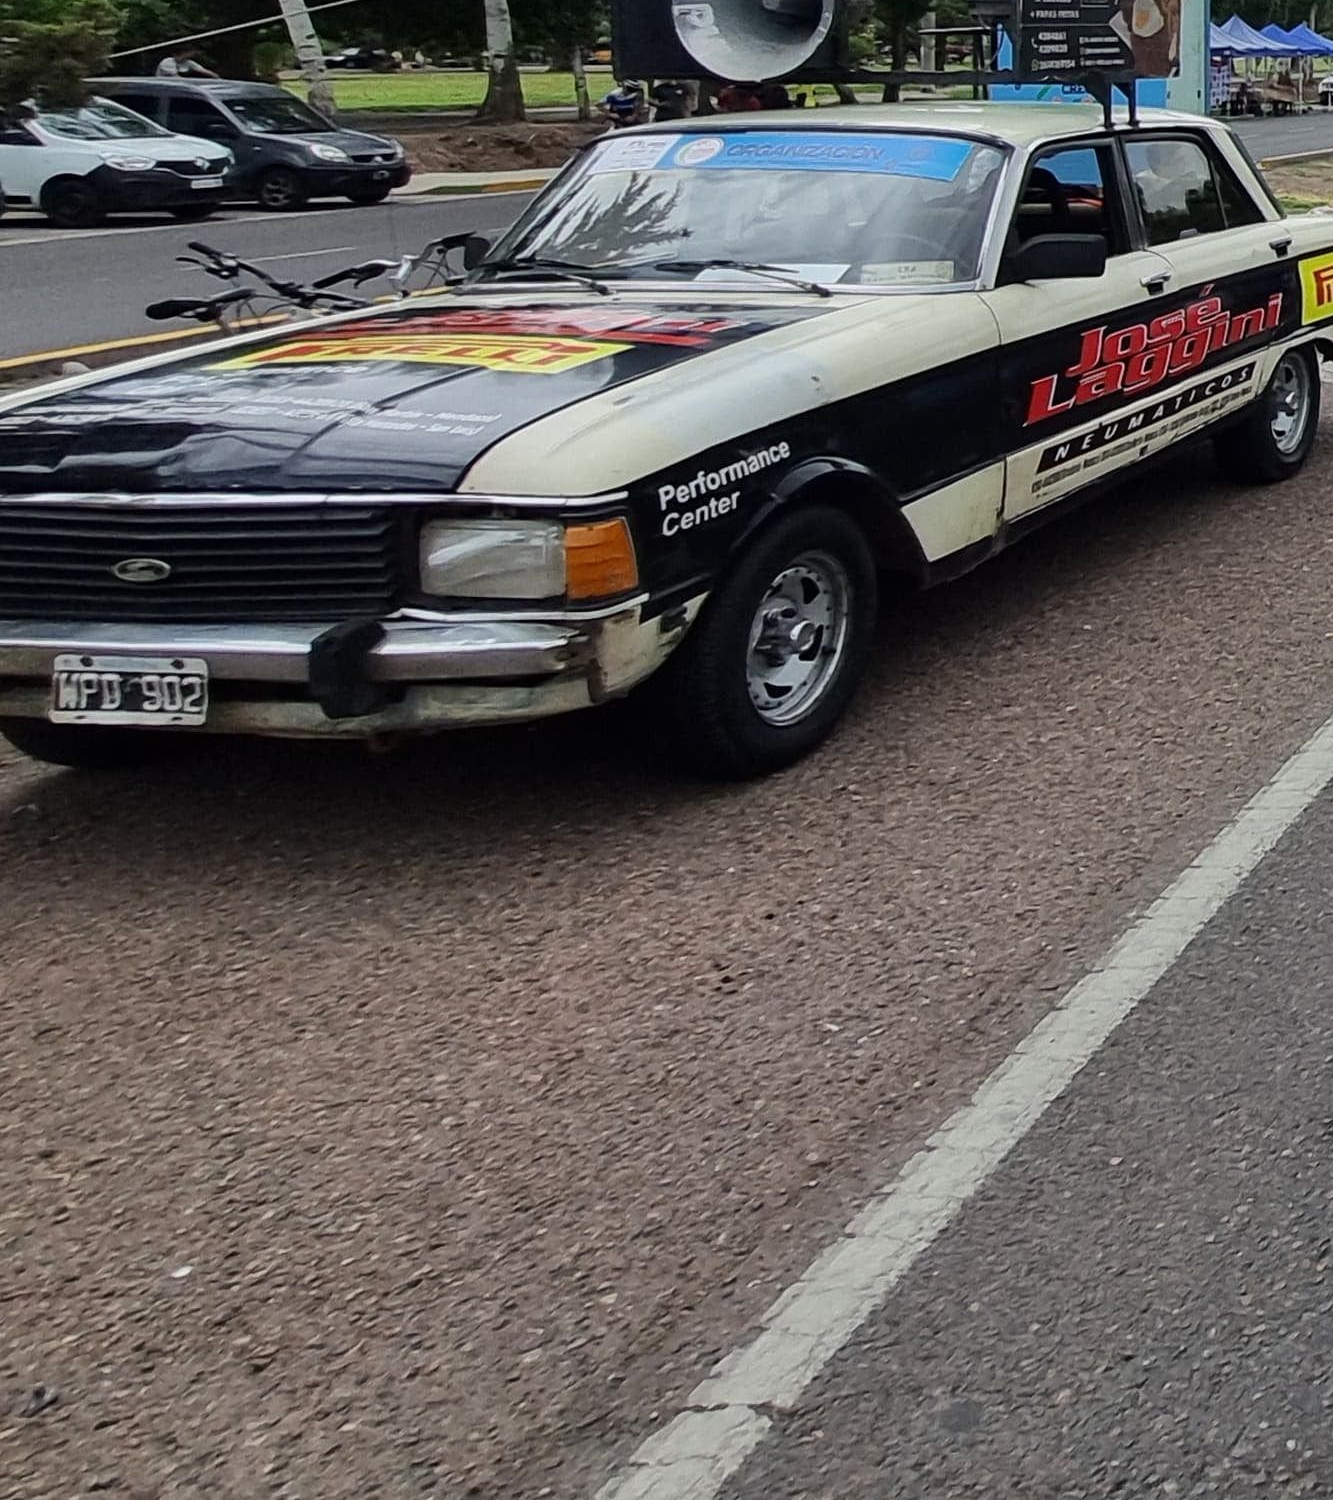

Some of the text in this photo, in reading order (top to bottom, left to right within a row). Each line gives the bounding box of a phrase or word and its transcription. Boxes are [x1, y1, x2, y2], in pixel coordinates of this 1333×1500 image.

[1024, 293, 1284, 426] Laggini
[1066, 284, 1222, 378] José
[1054, 367, 1249, 462] NEUMATICOS
[657, 440, 791, 512] Performance
[661, 490, 741, 537] Center
[141, 674, 202, 713] 902
